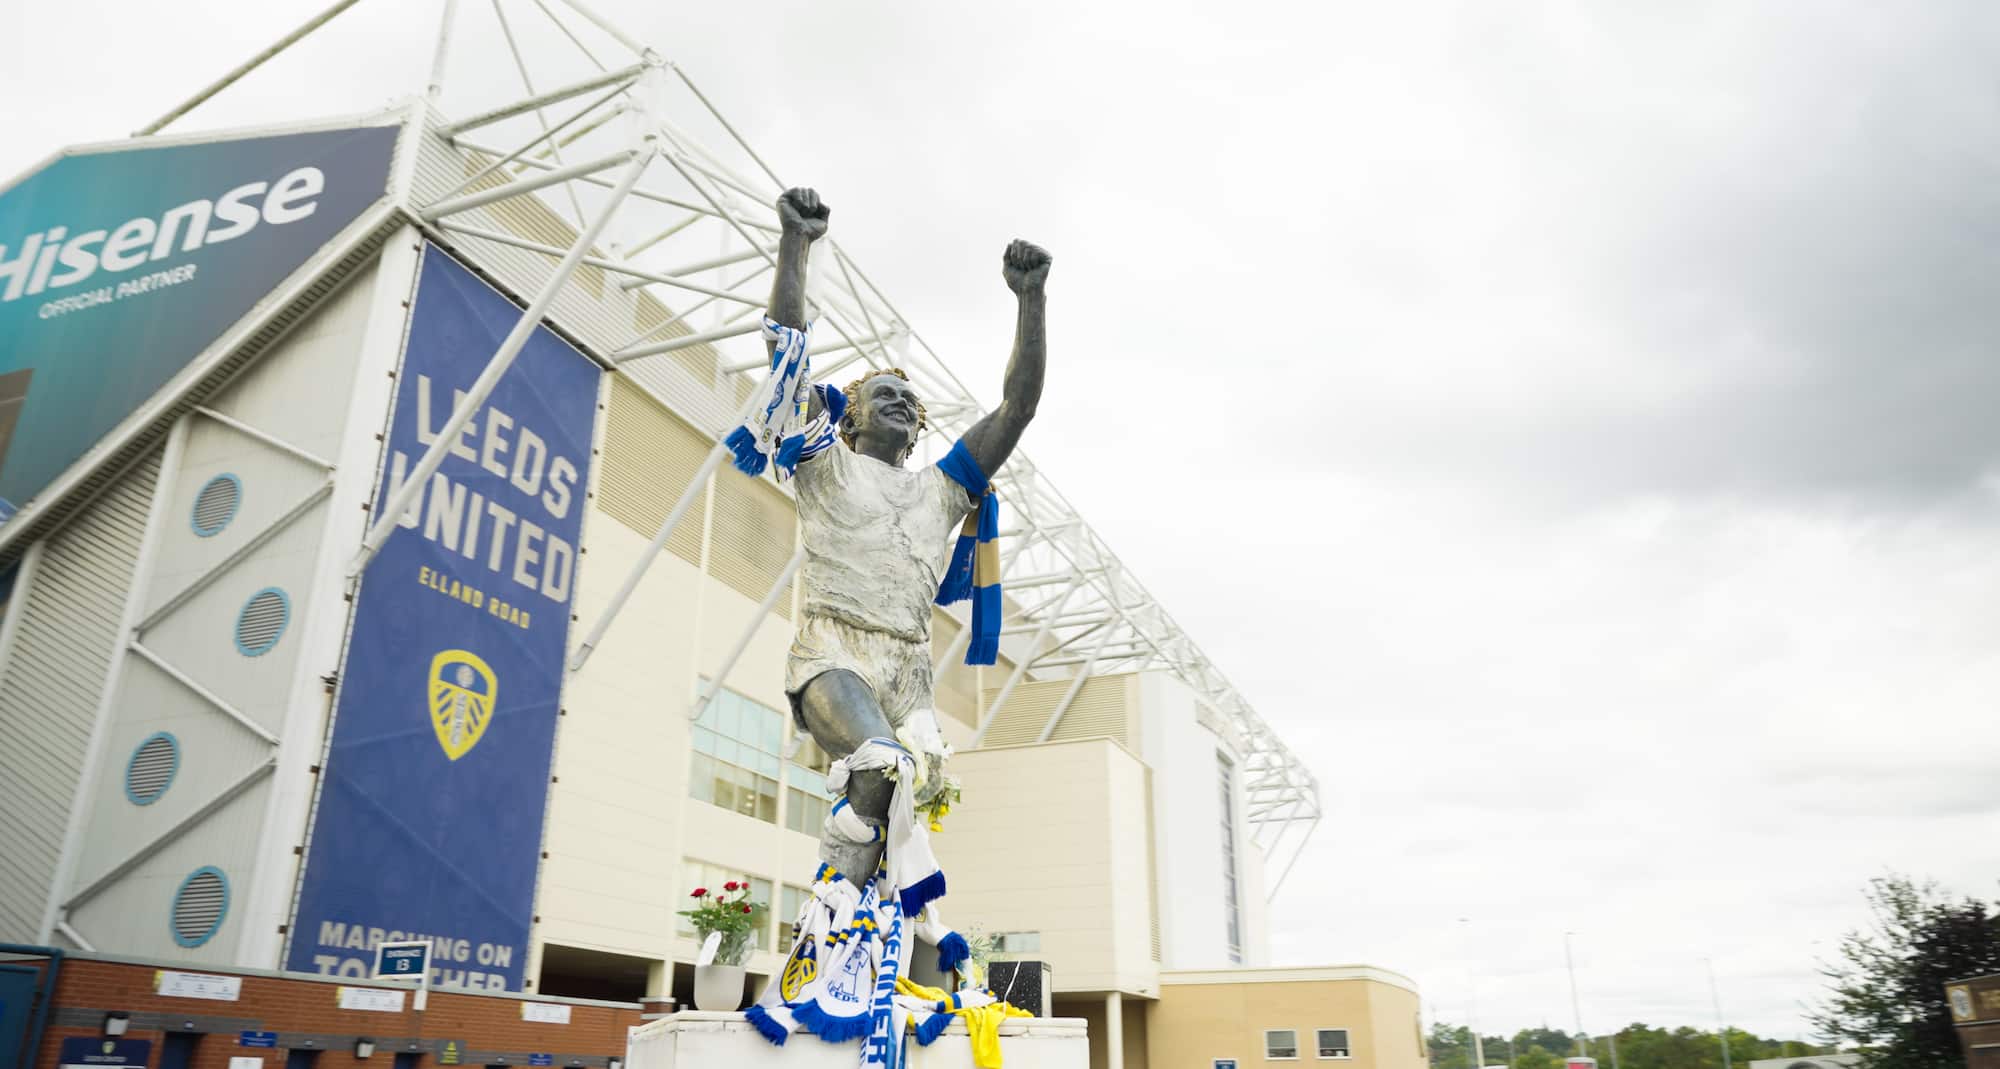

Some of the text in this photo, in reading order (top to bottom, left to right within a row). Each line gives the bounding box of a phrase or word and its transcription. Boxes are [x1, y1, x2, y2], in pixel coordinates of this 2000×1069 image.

[0, 166, 325, 301] Hisense
[39, 263, 198, 319] OFFICIAL PARTNER
[417, 374, 578, 519] LEEDS
[384, 451, 573, 603] UNITED
[418, 566, 531, 629] ELLAND ROAD
[313, 954, 507, 992] TOTHER
[318, 920, 513, 968] MARNG ON
